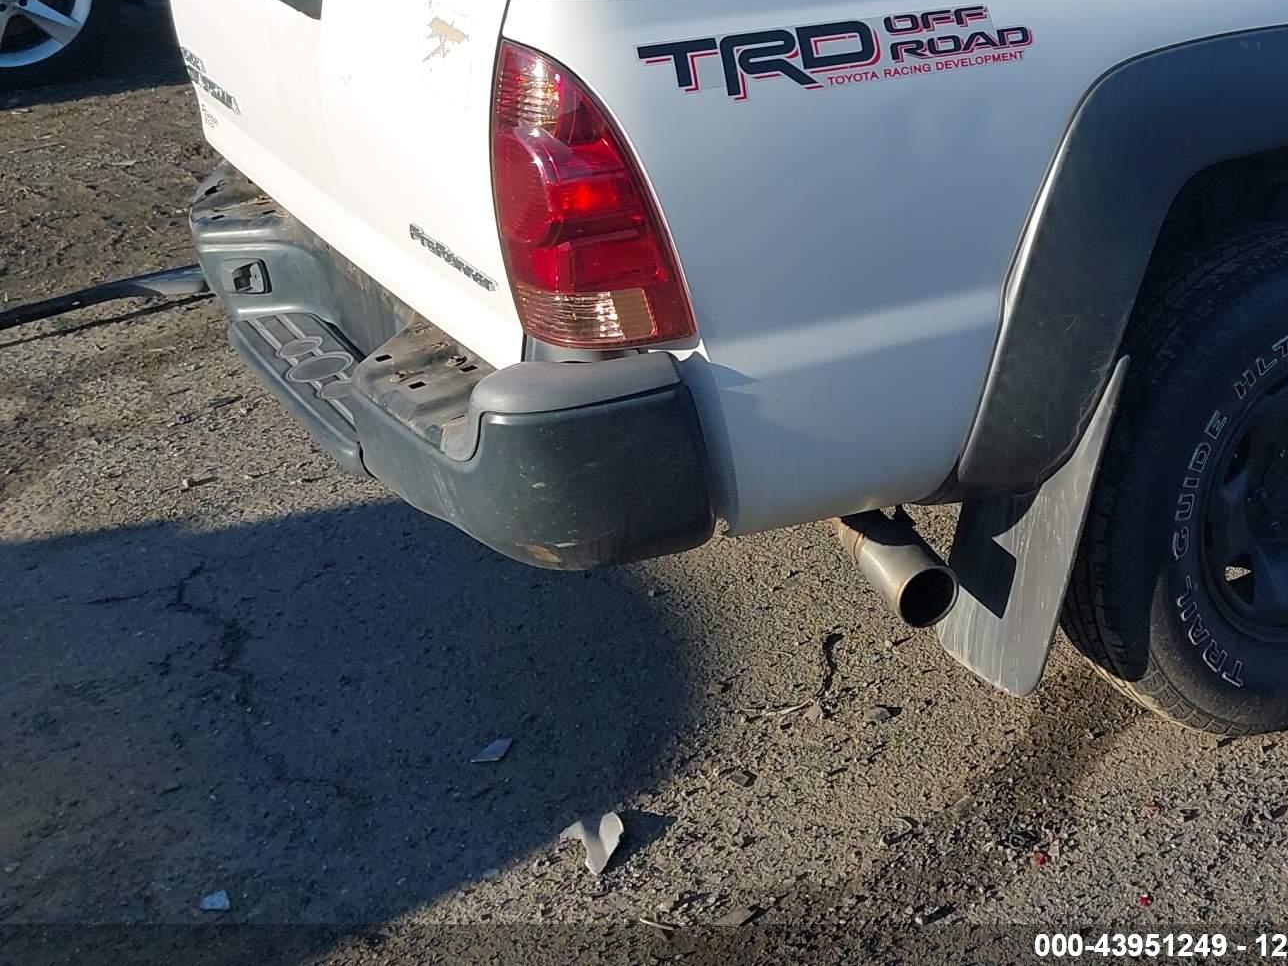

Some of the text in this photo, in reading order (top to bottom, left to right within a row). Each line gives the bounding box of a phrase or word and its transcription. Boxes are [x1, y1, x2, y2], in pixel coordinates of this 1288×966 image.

[883, 5, 987, 36] OFF
[890, 26, 1033, 63] ROAD
[636, 20, 881, 101] TRD
[828, 51, 1025, 86] TOYOTA RACING DEVELOPMENT
[1172, 410, 1227, 561] GUIDE
[1176, 576, 1245, 688] TRAIL
